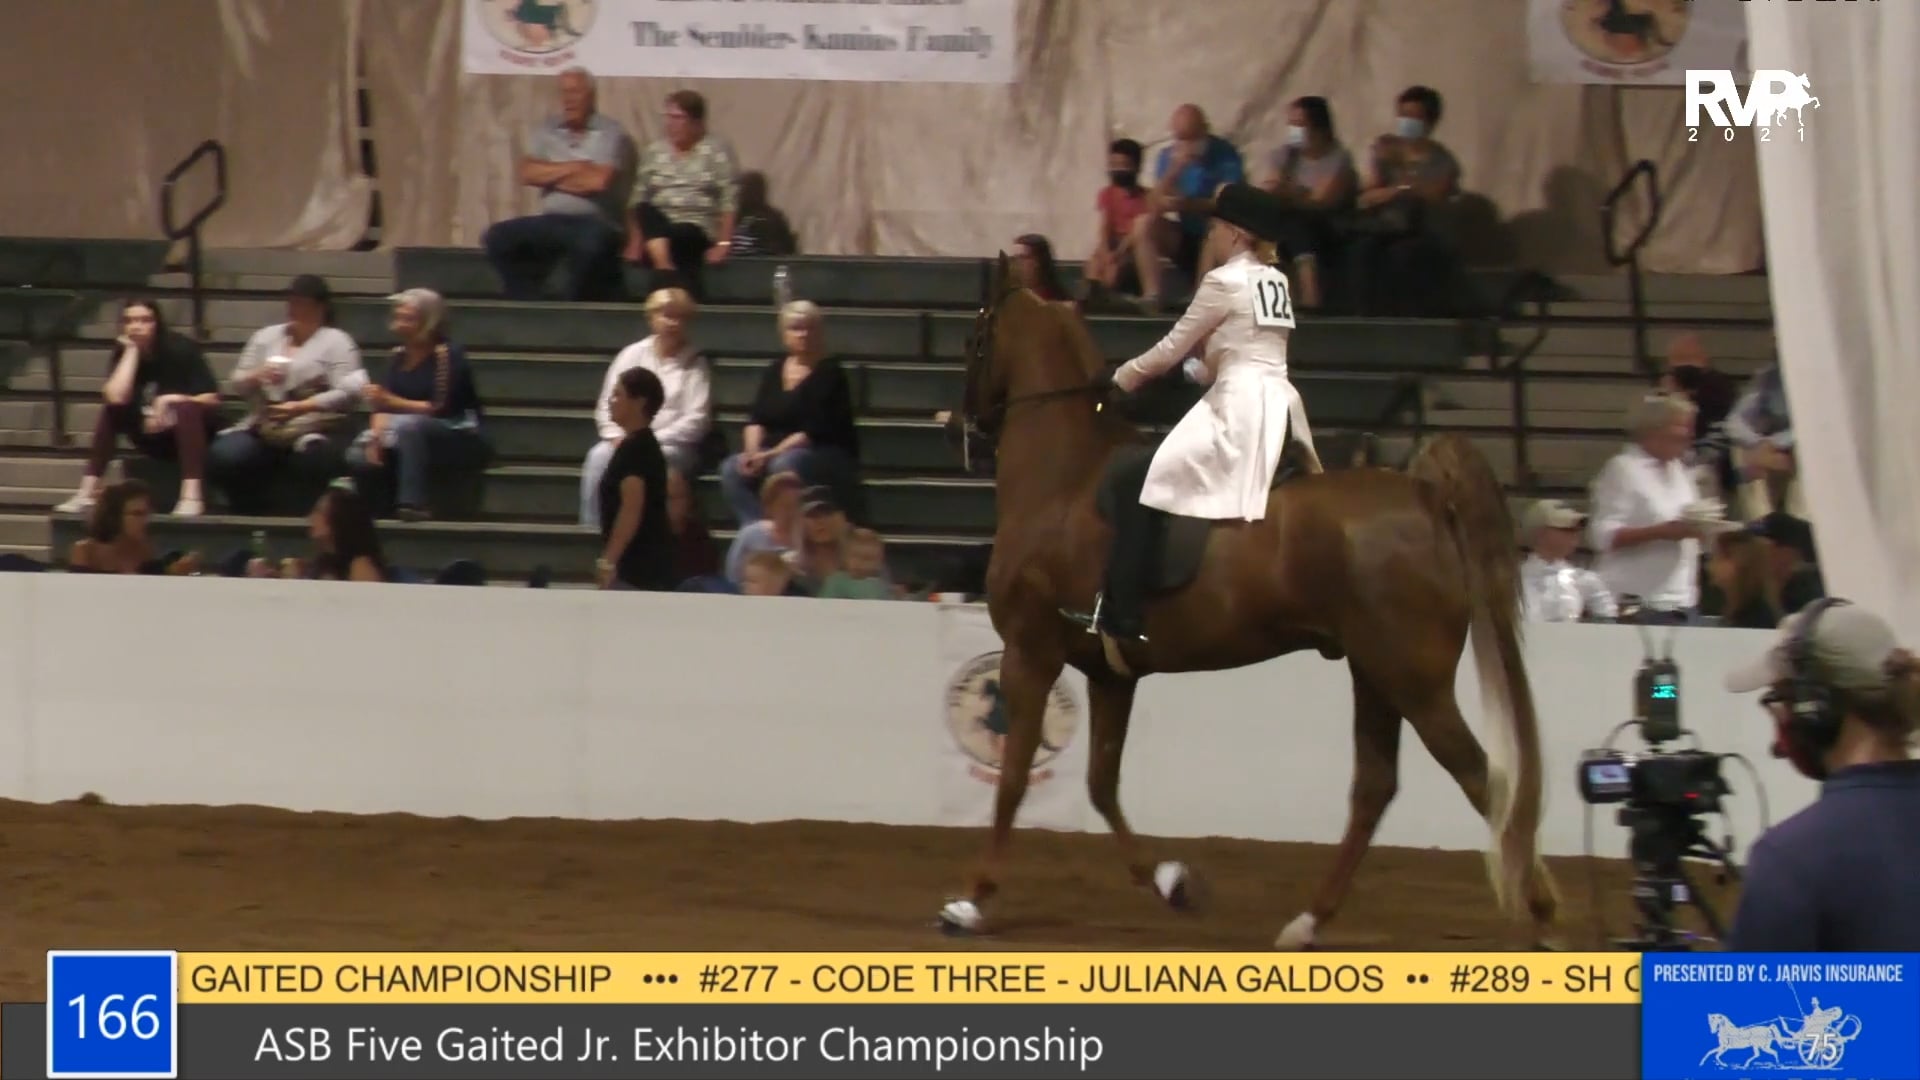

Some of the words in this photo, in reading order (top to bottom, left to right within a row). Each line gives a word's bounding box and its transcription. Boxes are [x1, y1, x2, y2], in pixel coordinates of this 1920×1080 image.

[631, 21, 680, 48] The
[906, 26, 993, 59] Family
[1256, 279, 1291, 320] 122
